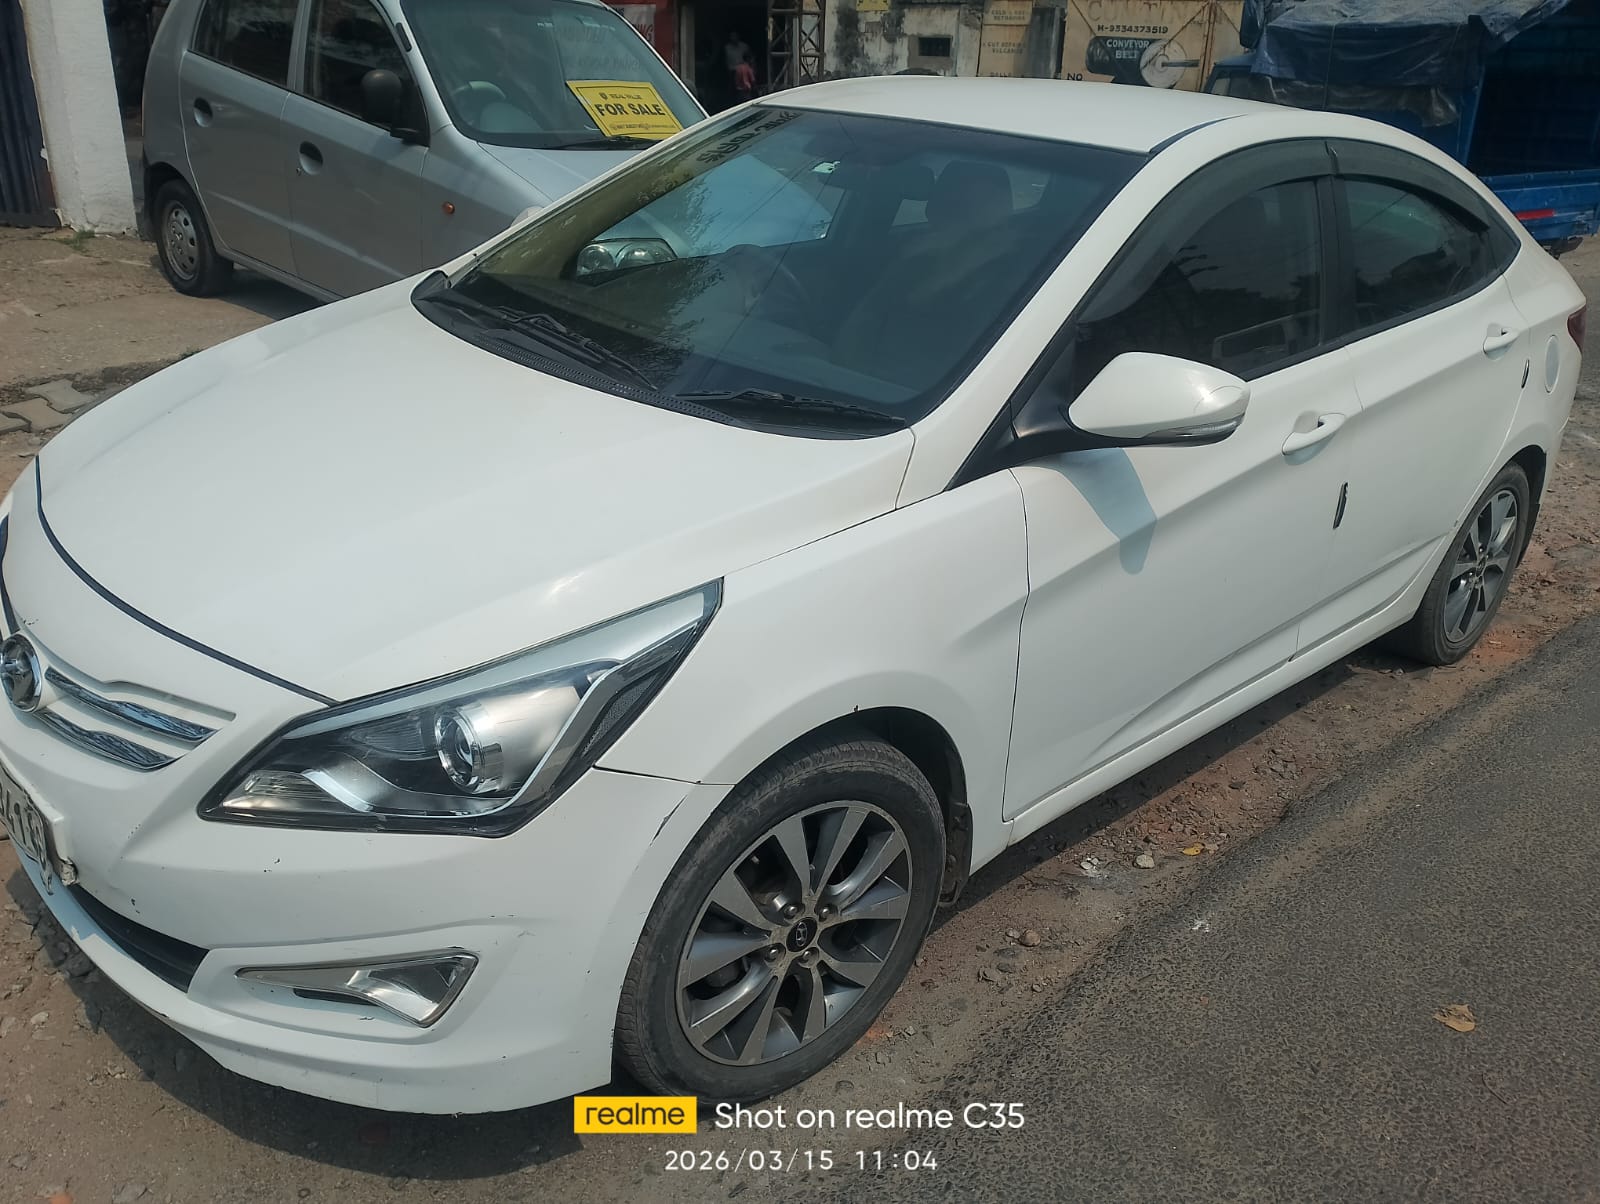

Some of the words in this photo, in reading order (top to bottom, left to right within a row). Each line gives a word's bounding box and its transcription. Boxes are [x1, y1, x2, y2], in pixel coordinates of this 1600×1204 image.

[1106, 39, 1150, 49] CONVEYOR
[1115, 50, 1137, 59] BELT
[594, 103, 629, 117] FOR
[627, 103, 666, 116] SALE
